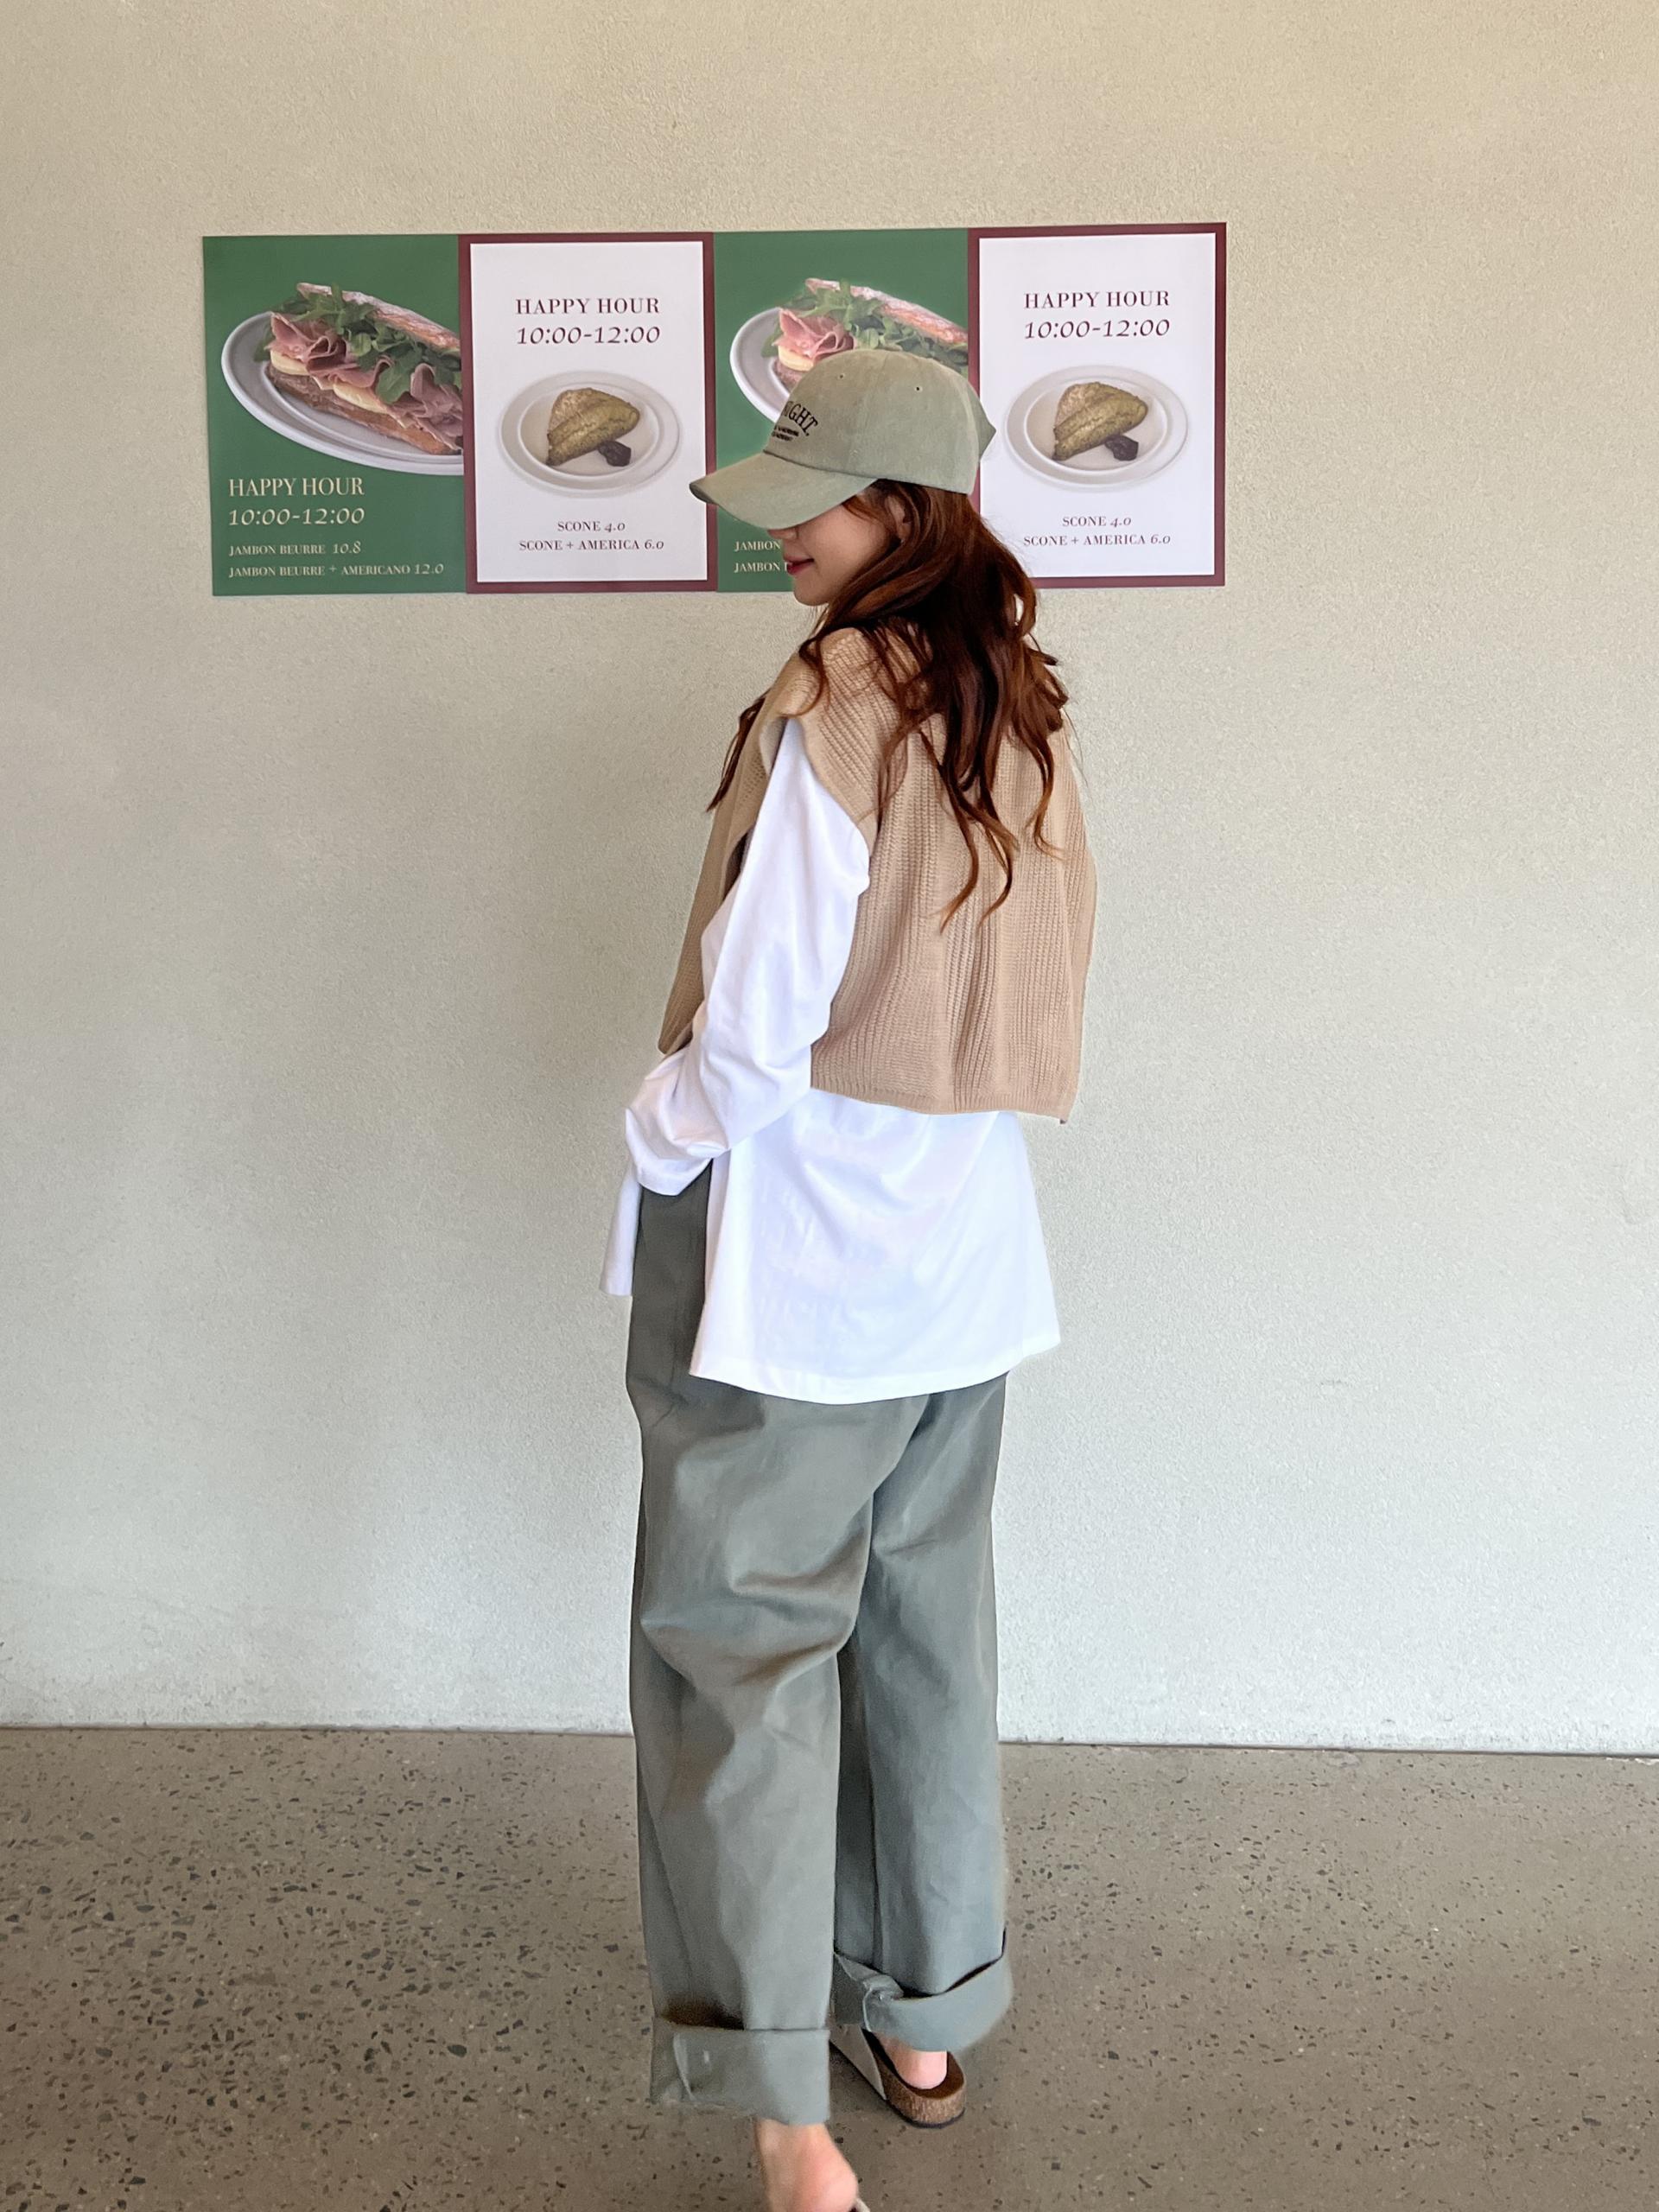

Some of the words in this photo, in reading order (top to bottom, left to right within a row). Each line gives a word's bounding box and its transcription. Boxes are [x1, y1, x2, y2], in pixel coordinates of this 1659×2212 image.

[516, 298, 590, 315] HAPPY
[596, 297, 660, 314] HOUR
[1024, 291, 1100, 309] HAPPY
[1106, 290, 1170, 308] HOUR
[517, 326, 660, 345] 10:00-12:00
[1025, 319, 1170, 339] 10:00-12:00
[228, 478, 297, 497] HAPPY
[302, 477, 365, 496] HOUR
[228, 507, 365, 525] 10:00-12:00
[1062, 516, 1107, 527] SCONE
[1110, 517, 1132, 528] 4.0
[557, 521, 601, 532] SCONE
[604, 522, 626, 533] 4.0
[518, 540, 563, 551] SCONE
[578, 539, 640, 550] AMERICA
[644, 539, 664, 550] 6.0
[734, 541, 781, 552] JAMBON
[1023, 536, 1068, 546] SCONE
[1083, 535, 1146, 545] AMERICA
[1150, 534, 1171, 545] 6.0
[229, 544, 276, 556] JAMBON
[279, 544, 326, 555] BEURRE
[332, 541, 361, 554] 10.8
[229, 566, 276, 578] JAMBON
[279, 565, 326, 576] BEURRE
[341, 565, 410, 575] AMERICANO
[414, 563, 444, 575] 12.0
[734, 562, 781, 573] JAMBON
